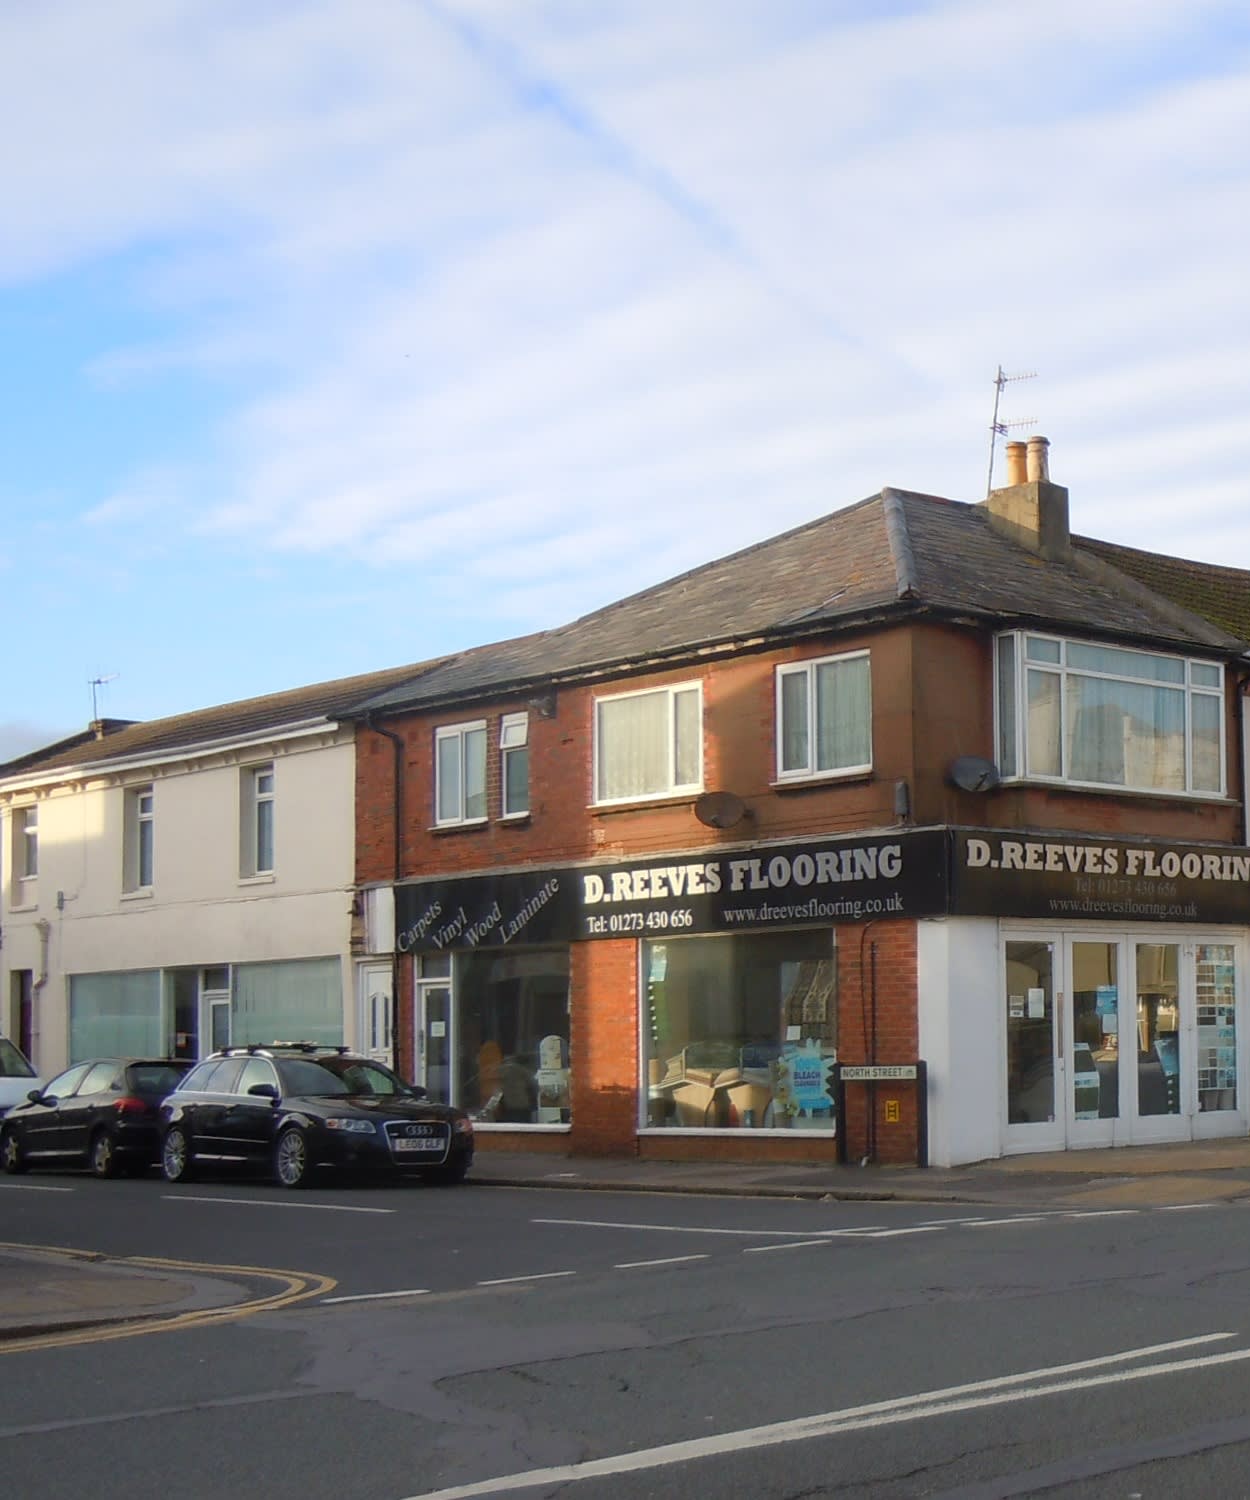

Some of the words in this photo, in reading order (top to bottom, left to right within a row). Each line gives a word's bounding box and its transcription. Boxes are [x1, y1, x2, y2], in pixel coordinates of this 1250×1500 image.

[583, 862, 722, 904] D.REEVES
[729, 845, 902, 891] FLOORING
[967, 839, 1119, 875] D.REEVES
[1098, 879, 1131, 894] 01273
[1135, 881, 1155, 896] 430
[1157, 883, 1177, 896] 656
[464, 901, 502, 948] Wood
[498, 878, 560, 945] Laminate
[587, 915, 608, 933] Tel:
[610, 913, 644, 931] 01273
[646, 911, 668, 929] 430
[670, 909, 693, 927] 656
[723, 892, 904, 922] www.dreevesflooring.co.uk
[1049, 897, 1198, 918] www.dreevesflooring.co.uk
[397, 900, 443, 952] Carpets
[431, 907, 468, 950] Vinyl
[842, 1068, 871, 1078] NORTH
[872, 1067, 902, 1077] STREET
